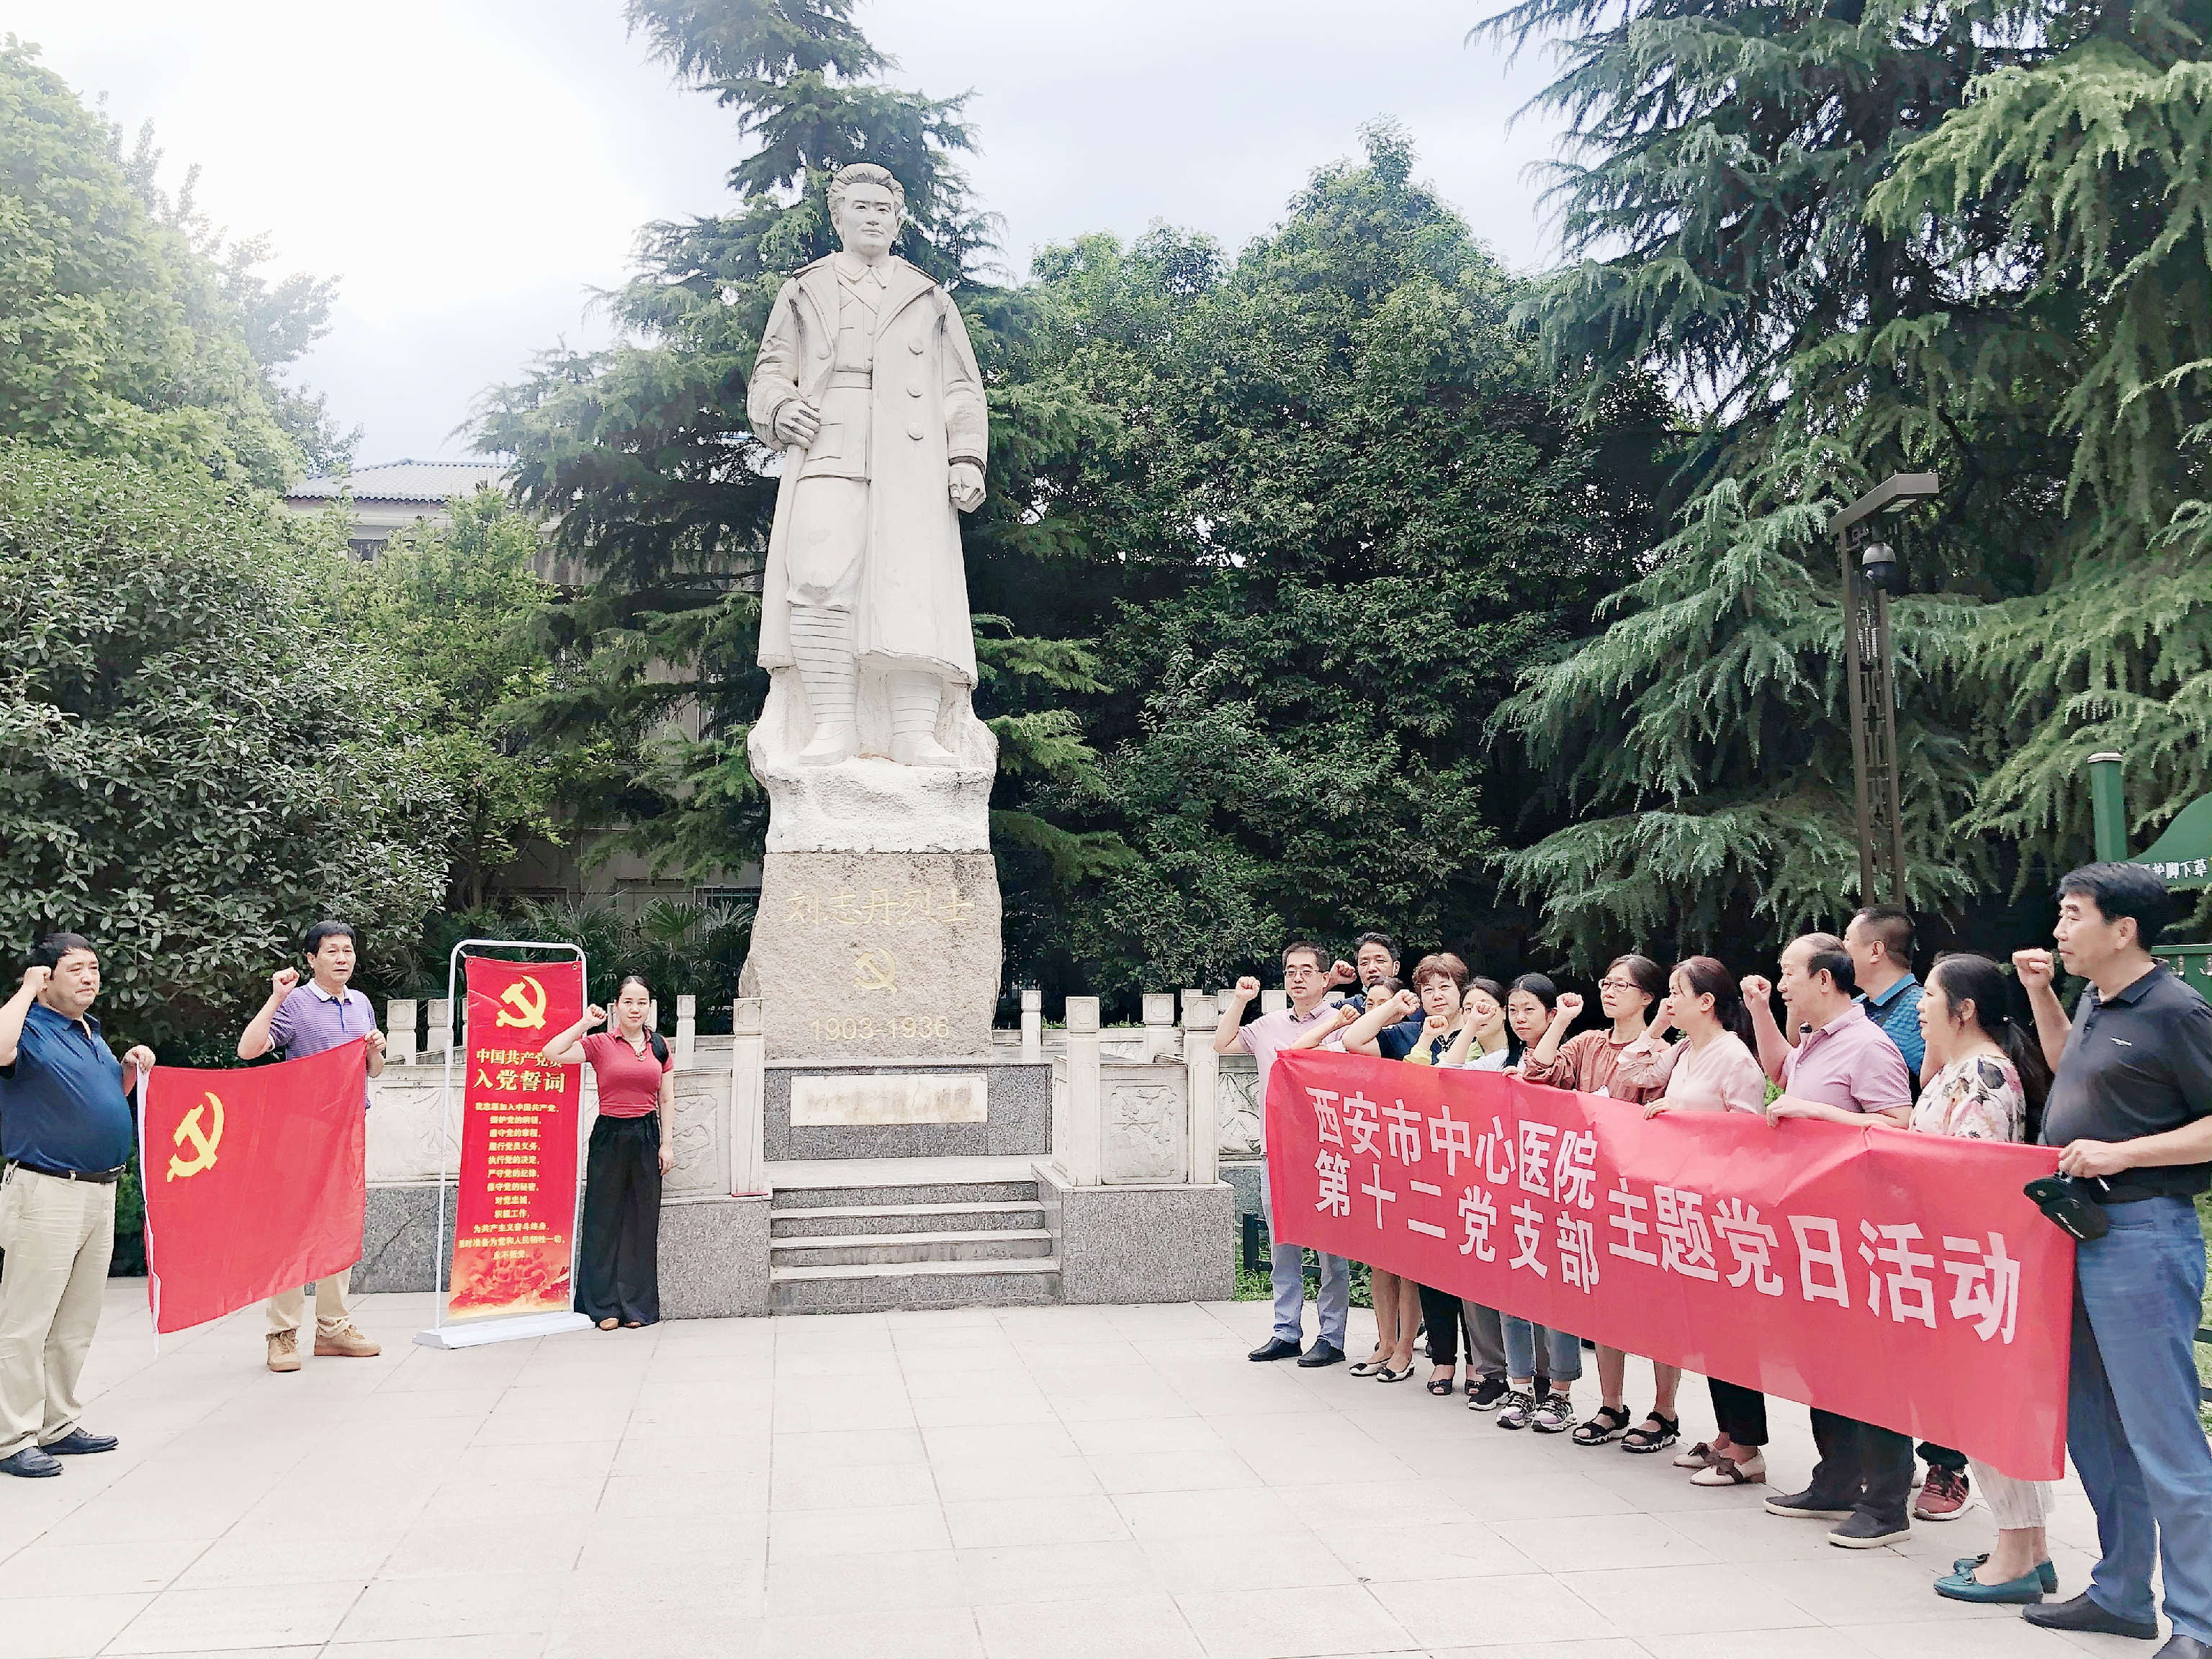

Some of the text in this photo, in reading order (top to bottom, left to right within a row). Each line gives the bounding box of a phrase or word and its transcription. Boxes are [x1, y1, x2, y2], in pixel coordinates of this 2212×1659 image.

[2141, 858, 2208, 880] 护脚下草
[785, 886, 975, 925] 刘志丹烈士
[811, 1015, 950, 1041] 1903-1936
[472, 1068, 566, 1093] 入党誓词
[1304, 1086, 1598, 1210] 西安市中心医院
[1314, 1148, 1600, 1295] 第十二党支部
[1606, 1177, 2020, 1345] 主题党日活动
